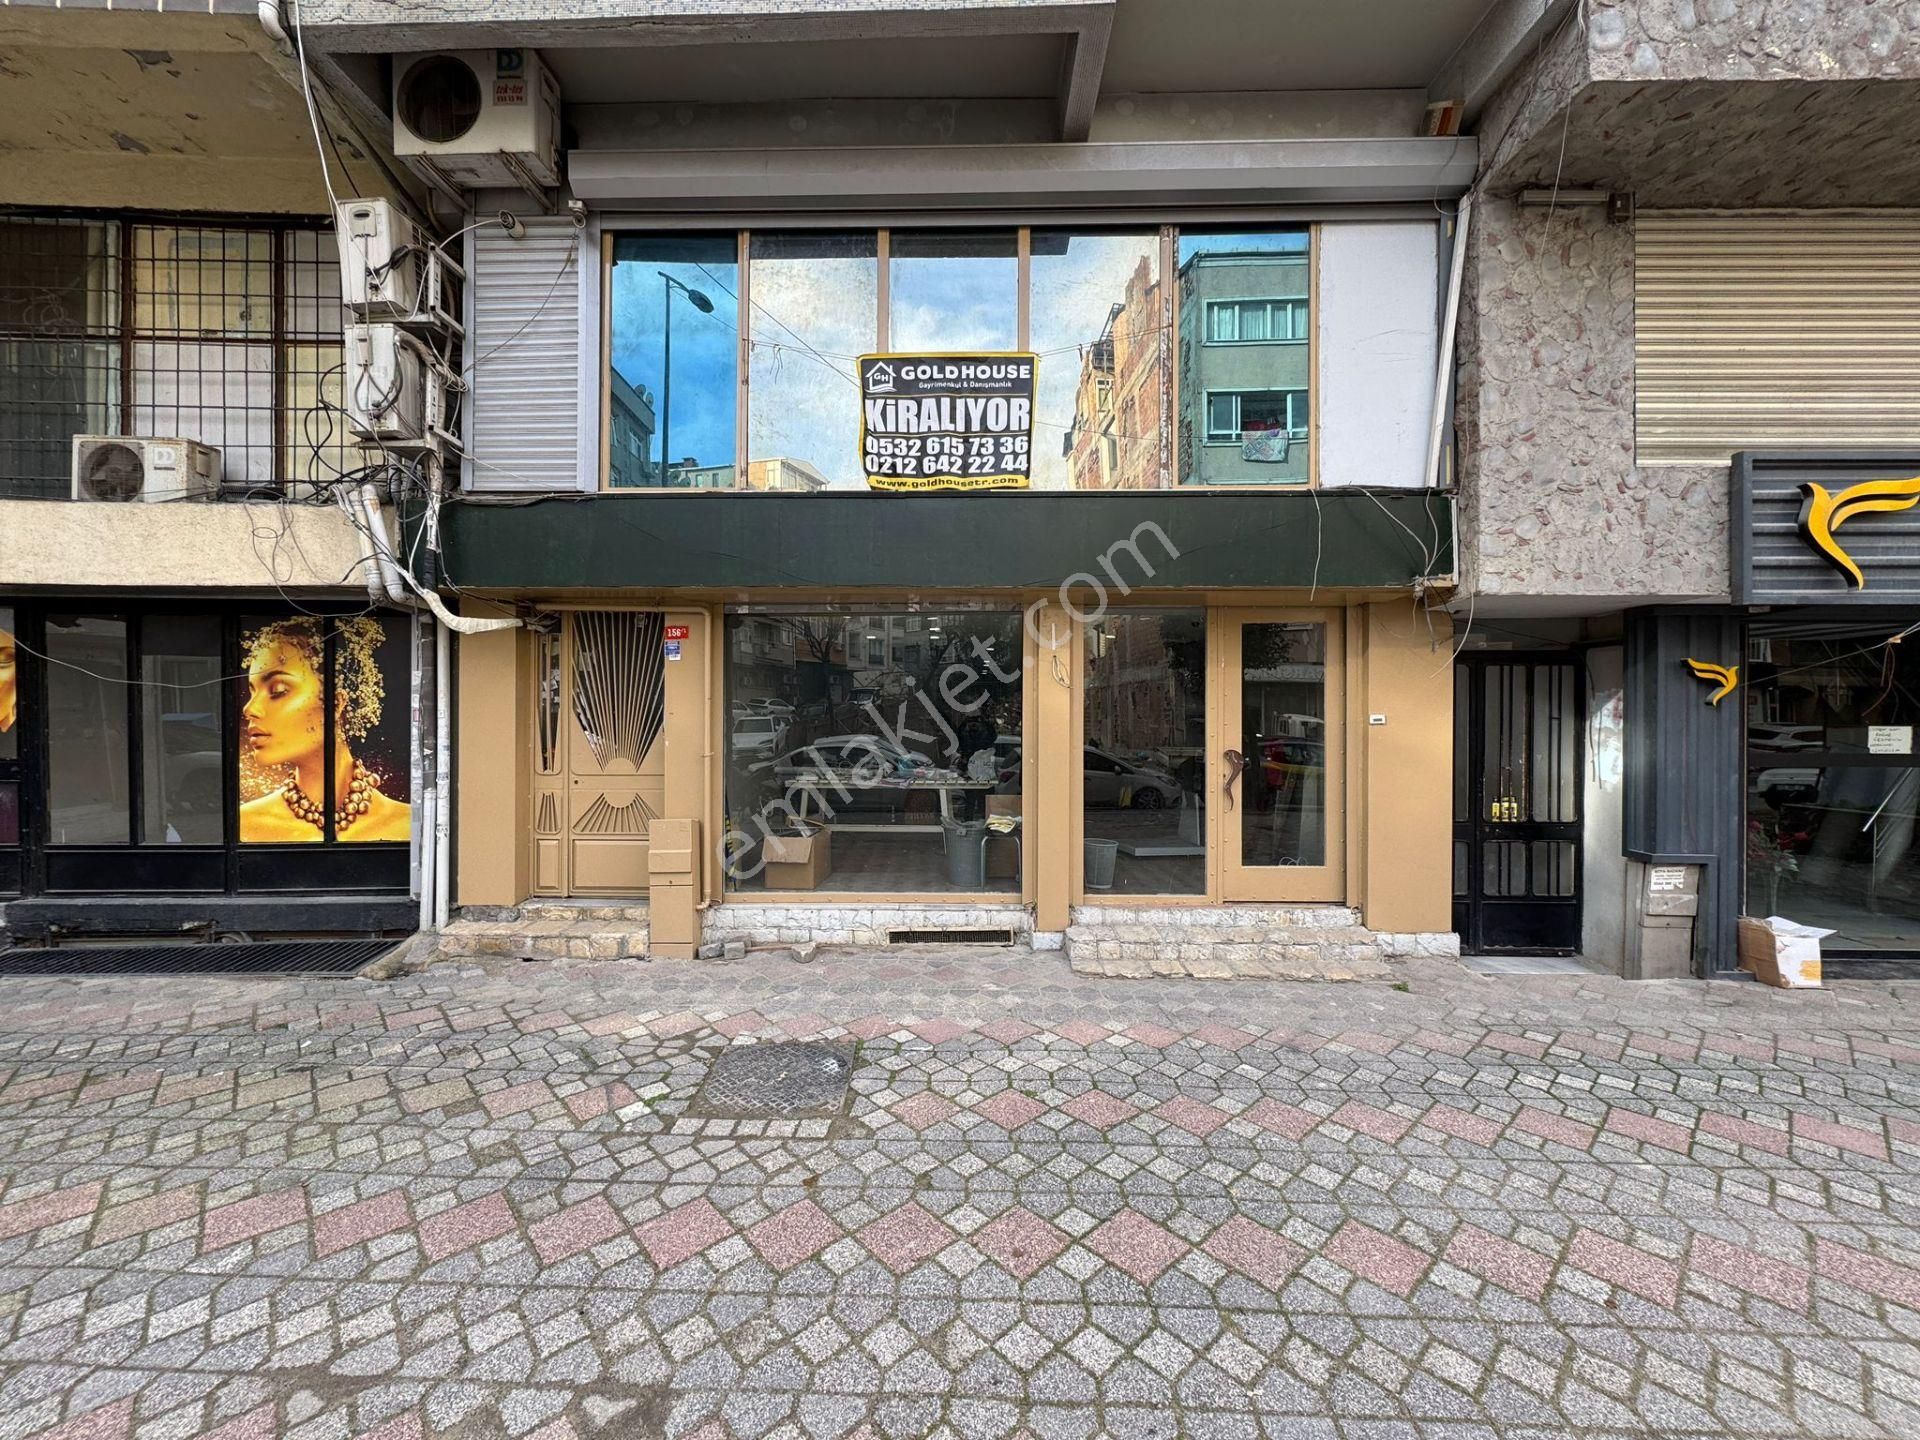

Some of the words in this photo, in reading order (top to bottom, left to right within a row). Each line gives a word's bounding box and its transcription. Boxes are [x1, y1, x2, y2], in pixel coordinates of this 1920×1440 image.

[919, 381, 961, 389] Gayrimenkul
[866, 436, 921, 456] 0532
[926, 437, 964, 456] 615
[969, 437, 994, 455] 73
[1000, 436, 1028, 453] 36
[865, 455, 917, 474] 0212
[923, 455, 962, 475] 642
[968, 456, 995, 473] 22
[1000, 454, 1028, 471] 44
[876, 478, 1018, 489] www.goldhousetr.com
